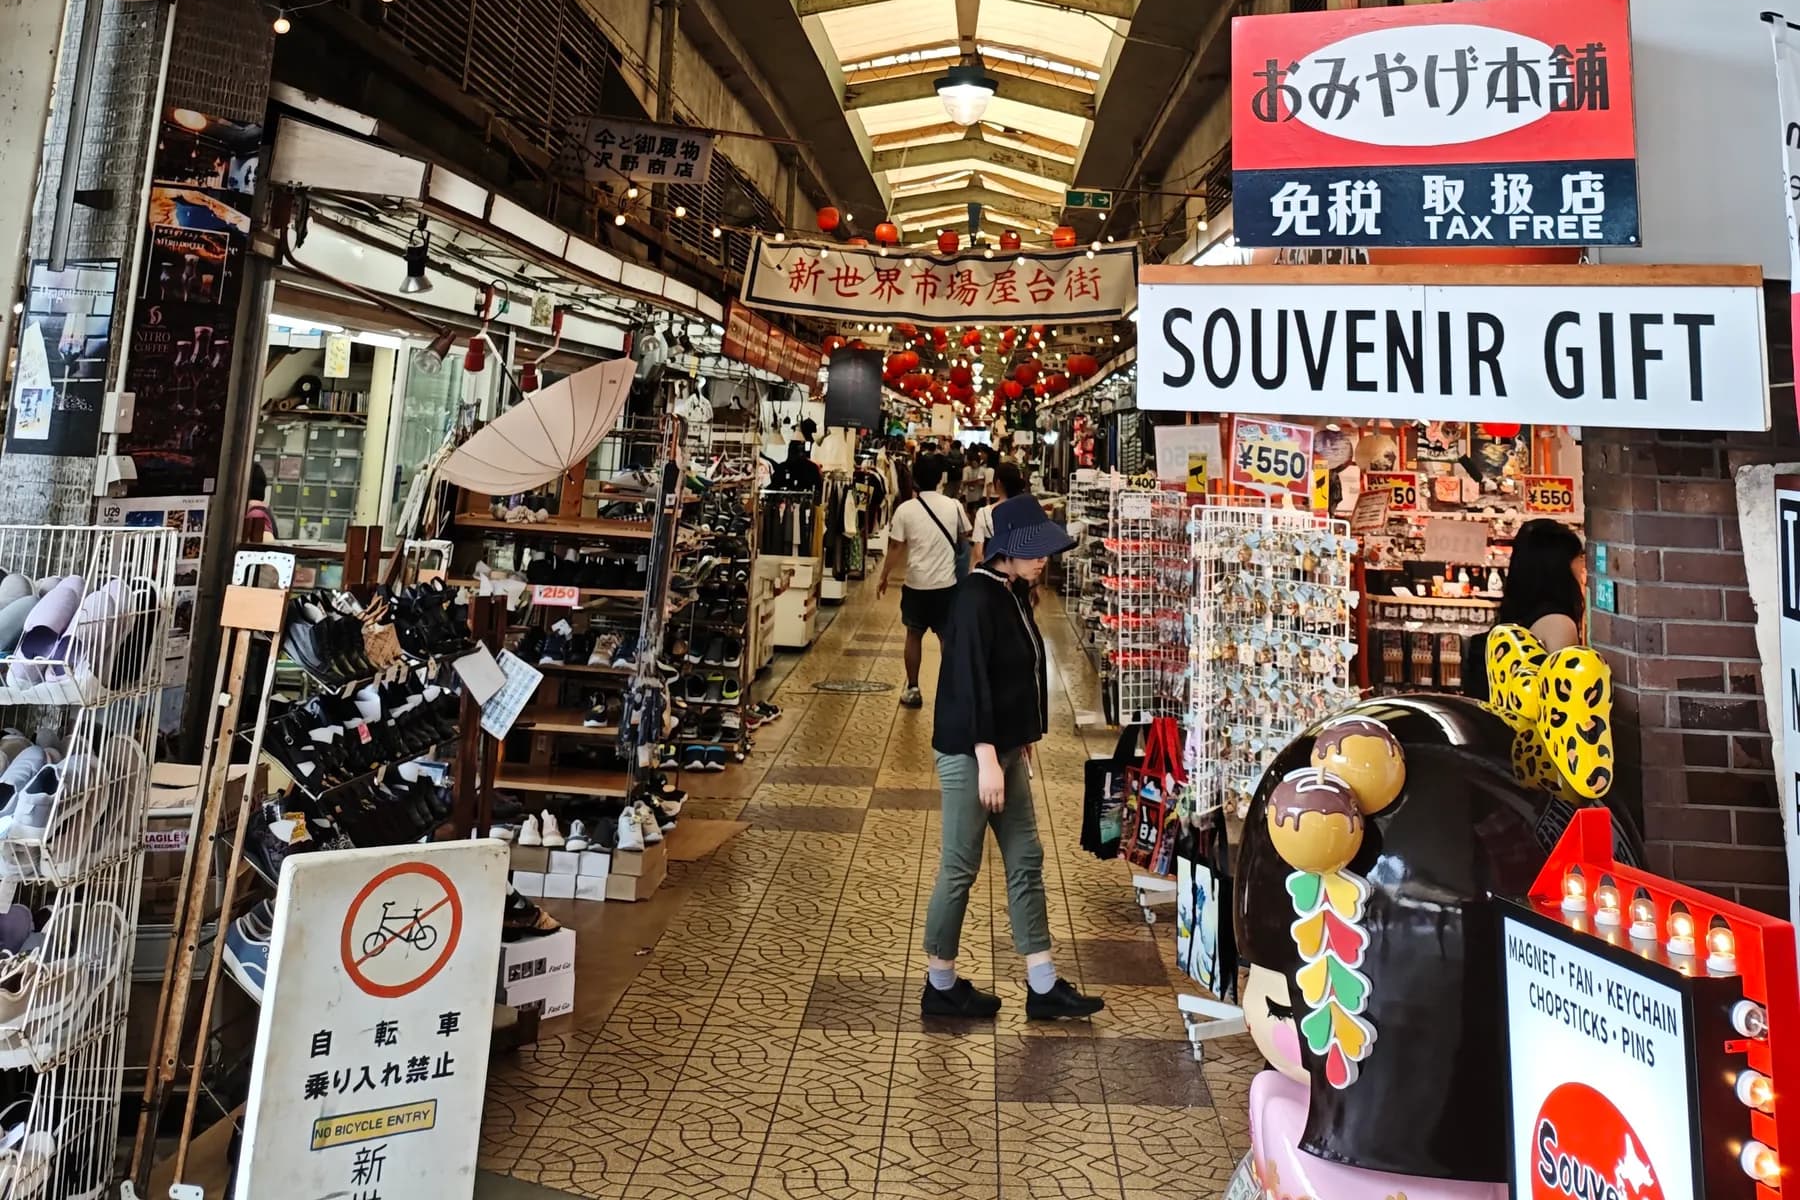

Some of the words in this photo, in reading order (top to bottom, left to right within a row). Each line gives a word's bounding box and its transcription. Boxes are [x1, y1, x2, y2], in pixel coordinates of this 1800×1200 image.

[1251, 42, 1611, 123] おみやげ本舗
[1270, 179, 1382, 237] 免税
[1422, 170, 1605, 216] 取扱店
[1424, 215, 1494, 240] TAX
[1508, 214, 1604, 240] FREE
[788, 256, 1104, 306] 新世界市場屋台街
[1162, 307, 1508, 398] SOUVENIR
[1543, 310, 1716, 402] GIFT
[1238, 443, 1306, 480] ¥550
[1528, 489, 1572, 506] ¥550
[1508, 934, 1557, 980] MAGNET
[1568, 961, 1594, 998] FAN
[1606, 978, 1678, 1037] KEYCHAIN
[310, 1011, 461, 1059] 自転車
[1529, 982, 1609, 1044] CHOPSTICKS
[1622, 1026, 1656, 1068] PINS
[304, 1051, 455, 1101] 乗り入れ禁止
[314, 1126, 332, 1140] NO
[334, 1117, 383, 1137] BICYCLE
[386, 1109, 430, 1127] ENTRY
